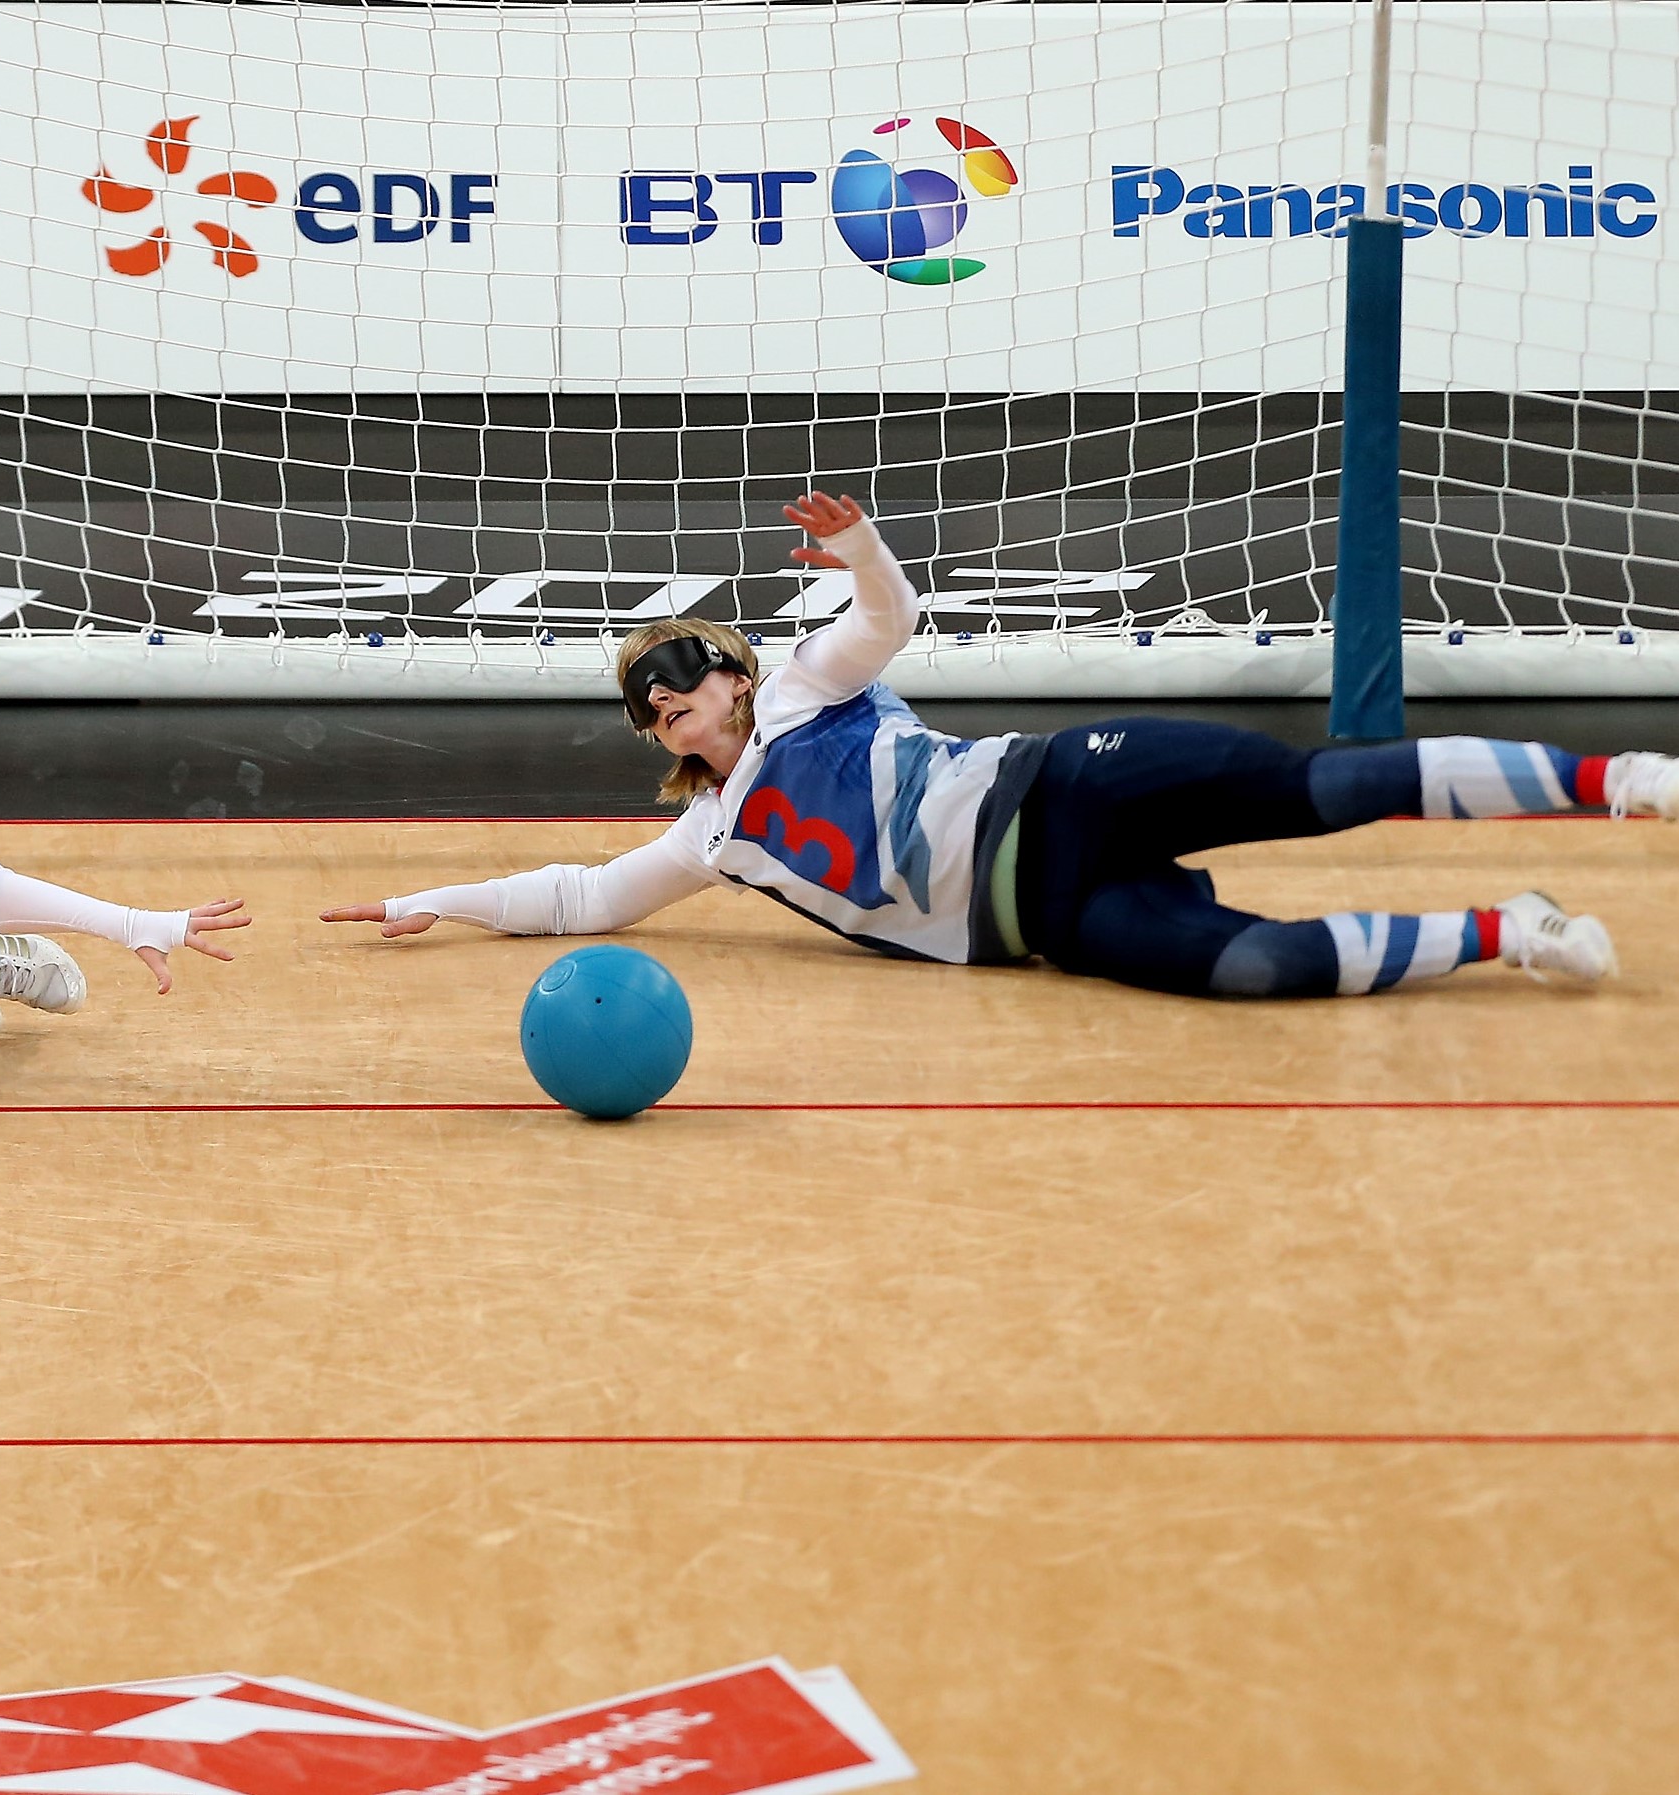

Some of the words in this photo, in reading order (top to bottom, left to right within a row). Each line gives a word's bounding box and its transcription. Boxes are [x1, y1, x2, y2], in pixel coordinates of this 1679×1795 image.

[620, 169, 817, 246] BT
[1111, 165, 1658, 239] Panasonic
[743, 786, 855, 893] 3
